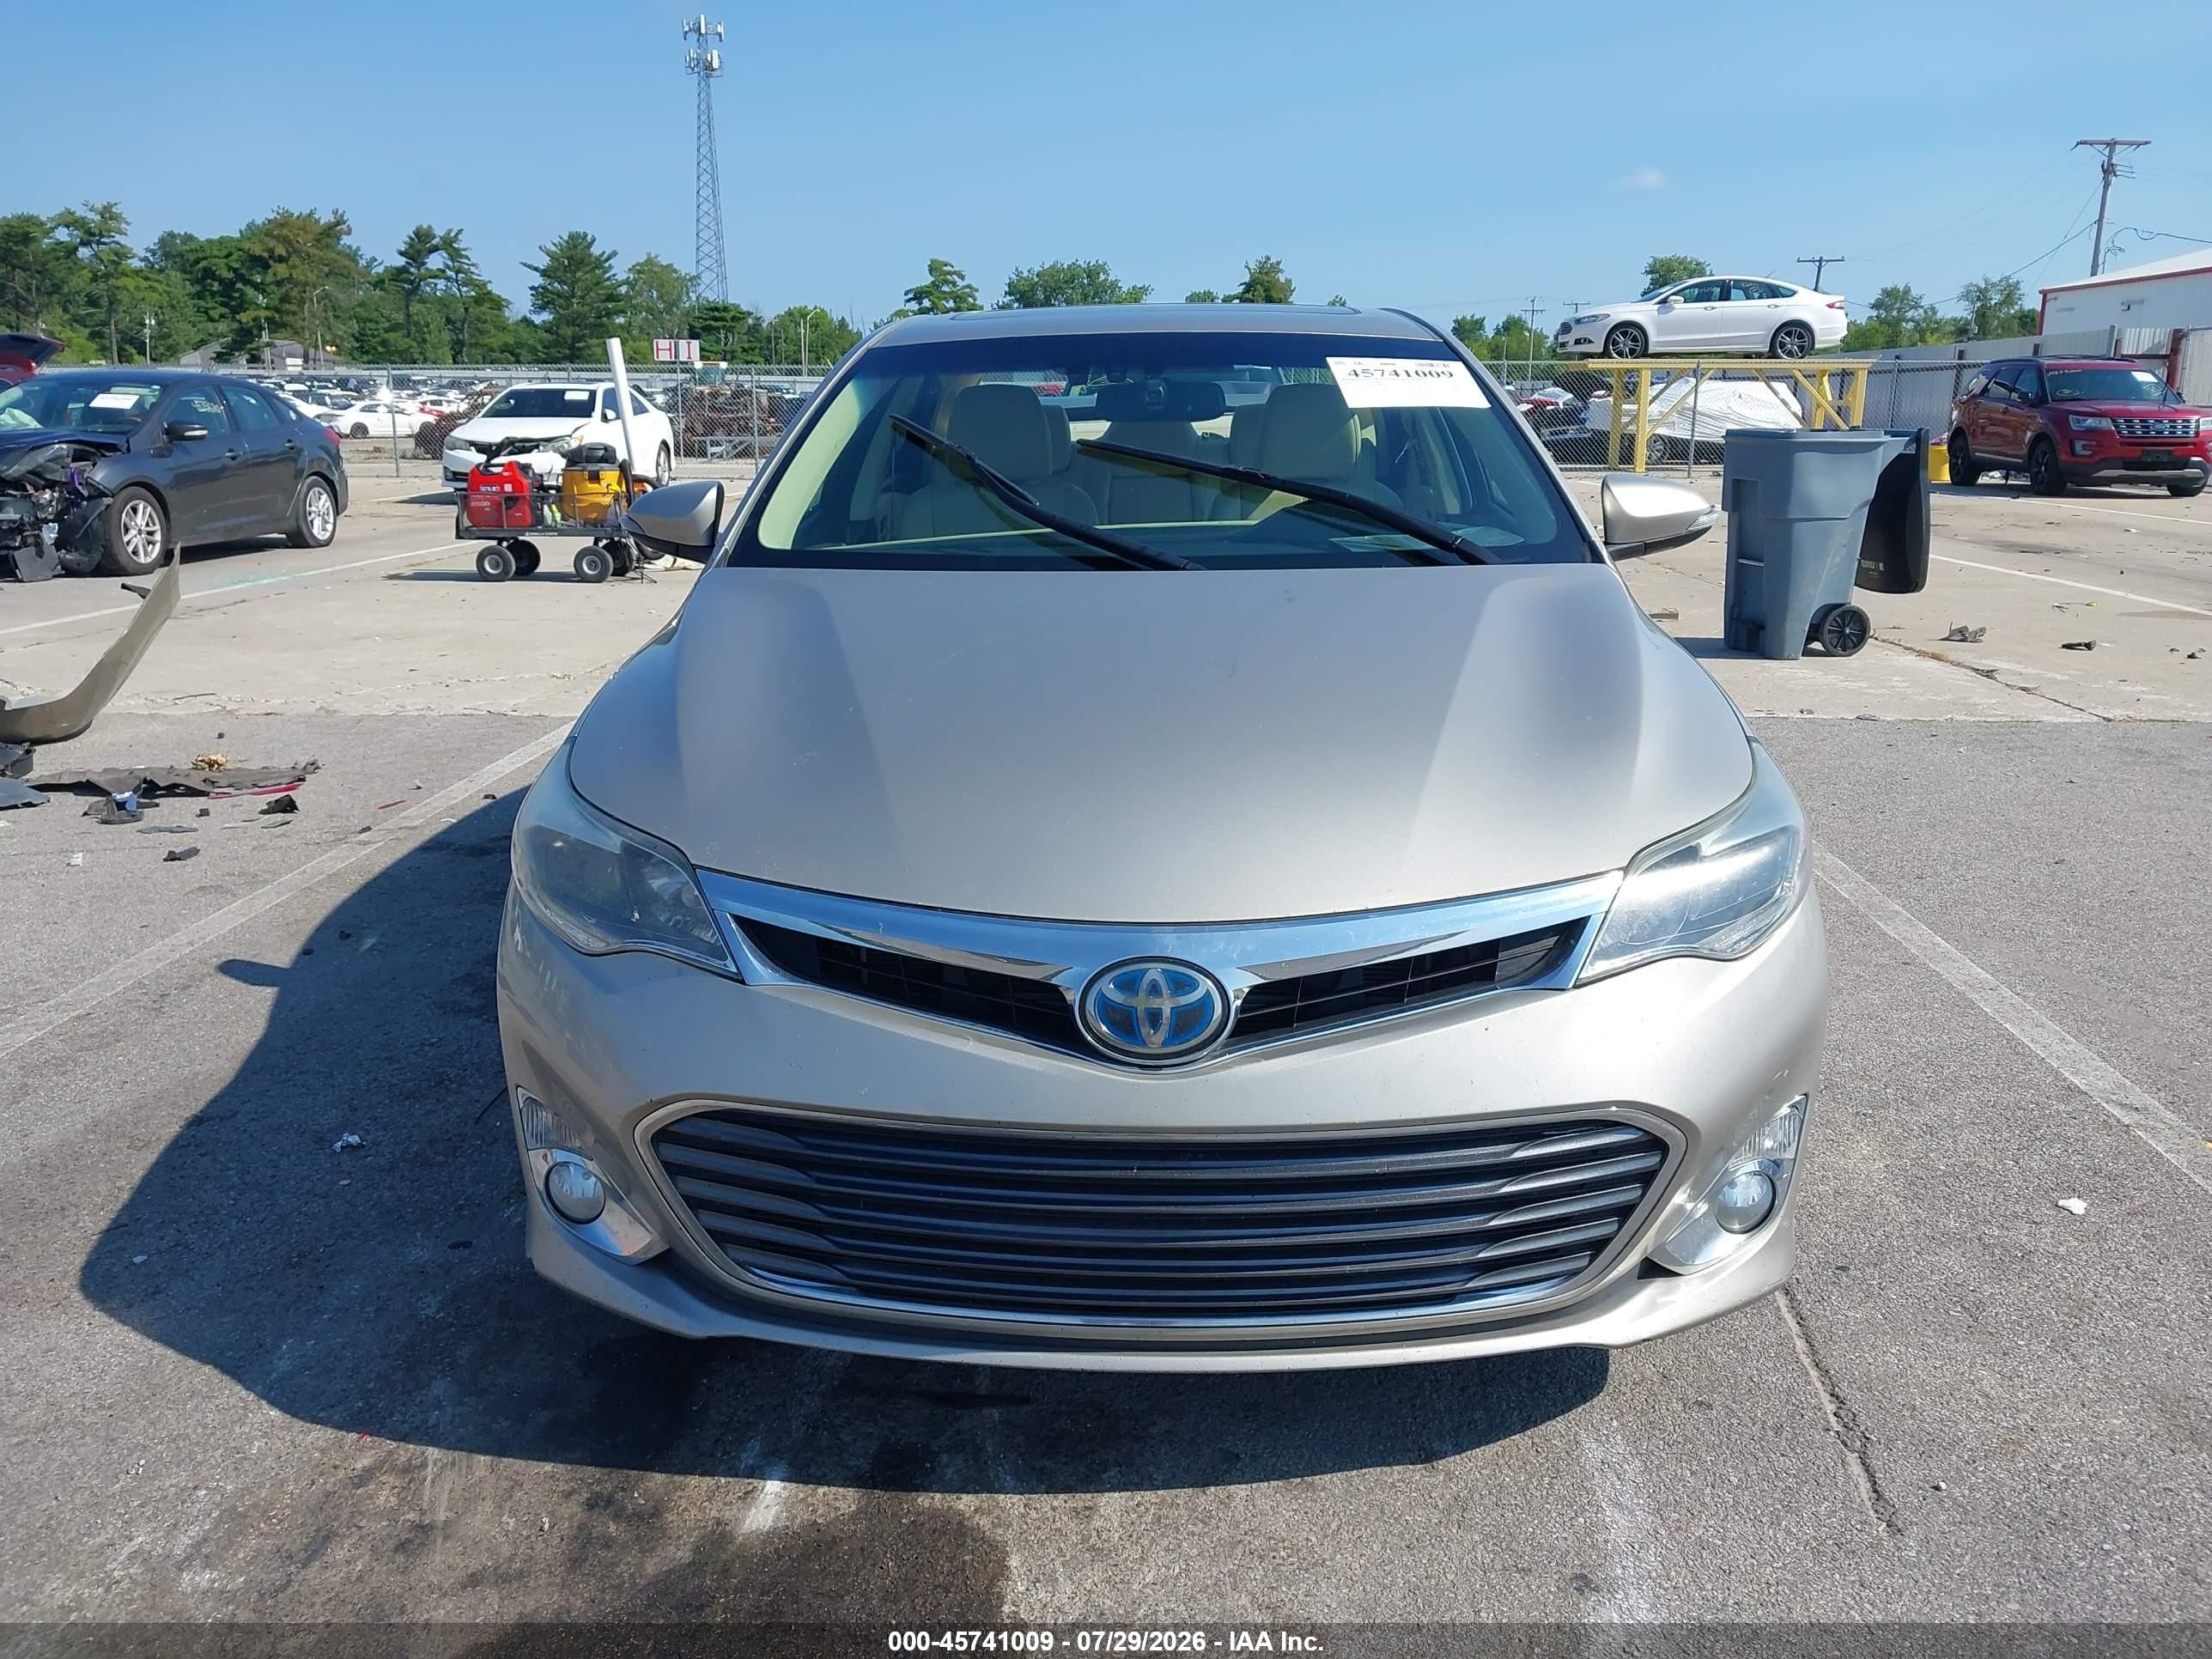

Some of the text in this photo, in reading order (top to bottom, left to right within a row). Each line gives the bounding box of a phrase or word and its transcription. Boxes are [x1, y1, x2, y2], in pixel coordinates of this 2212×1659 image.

[655, 341, 692, 360] H I
[1347, 368, 1454, 379] 45741009
